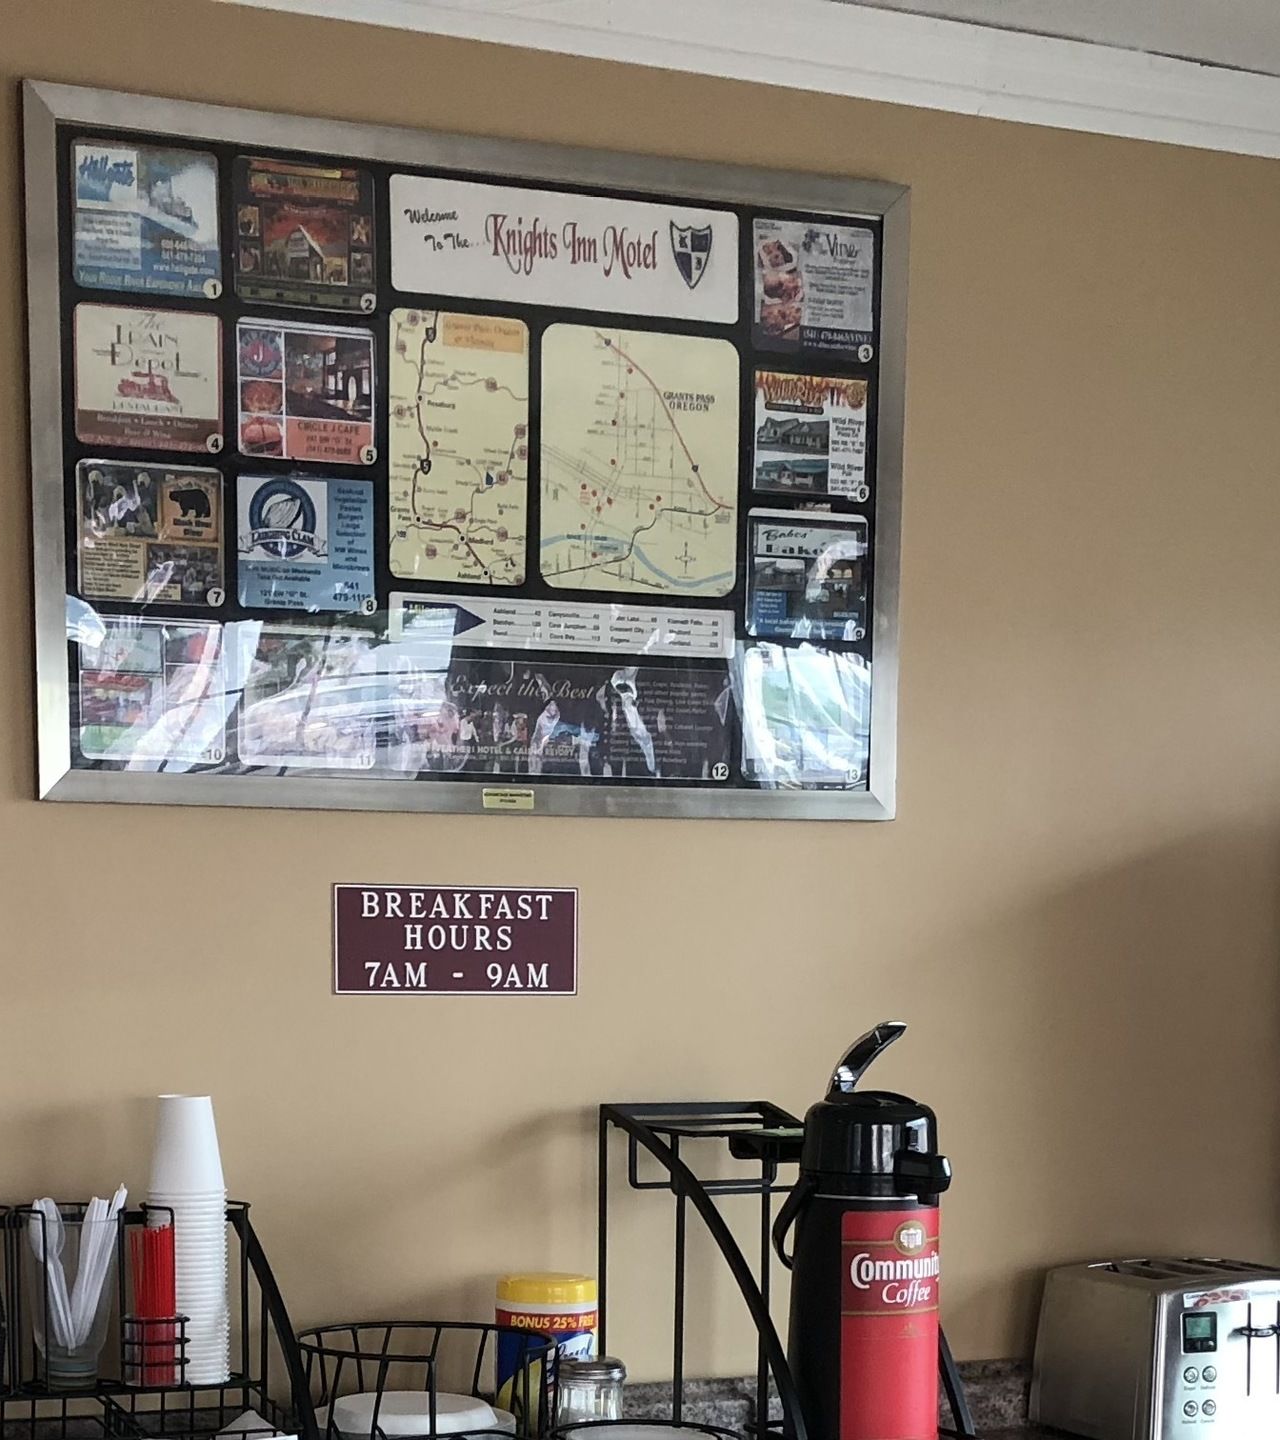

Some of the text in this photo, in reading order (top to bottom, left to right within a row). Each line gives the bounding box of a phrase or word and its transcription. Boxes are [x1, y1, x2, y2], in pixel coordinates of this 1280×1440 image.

[403, 208, 459, 225] Welcome
[423, 234, 444, 252] To
[484, 213, 659, 280] Knights Inn Motel
[210, 282, 218, 296] 1
[364, 297, 374, 311] 2
[253, 344, 264, 362] J
[862, 346, 871, 360] 3
[662, 391, 716, 404] GRANTS PASS
[668, 402, 711, 412] OREGON
[337, 424, 361, 436] CAFE
[210, 437, 220, 450] 4
[365, 449, 374, 463] 5
[422, 461, 430, 471] 5
[858, 487, 867, 499] 6
[291, 528, 315, 547] CLAM
[212, 590, 222, 604] 7
[365, 599, 375, 612] 8
[551, 678, 594, 699] Best
[205, 749, 223, 762] 10
[477, 745, 503, 755] HOTEL
[713, 766, 728, 778] 12
[845, 768, 860, 781] 13
[360, 890, 554, 921] BREAKFAST
[403, 924, 513, 951] HOURS
[364, 961, 428, 988] 7AM
[486, 962, 550, 989] 9AM
[881, 1279, 932, 1308] Coffee
[510, 1314, 551, 1329] BONUS
[552, 1316, 577, 1329] 25%
